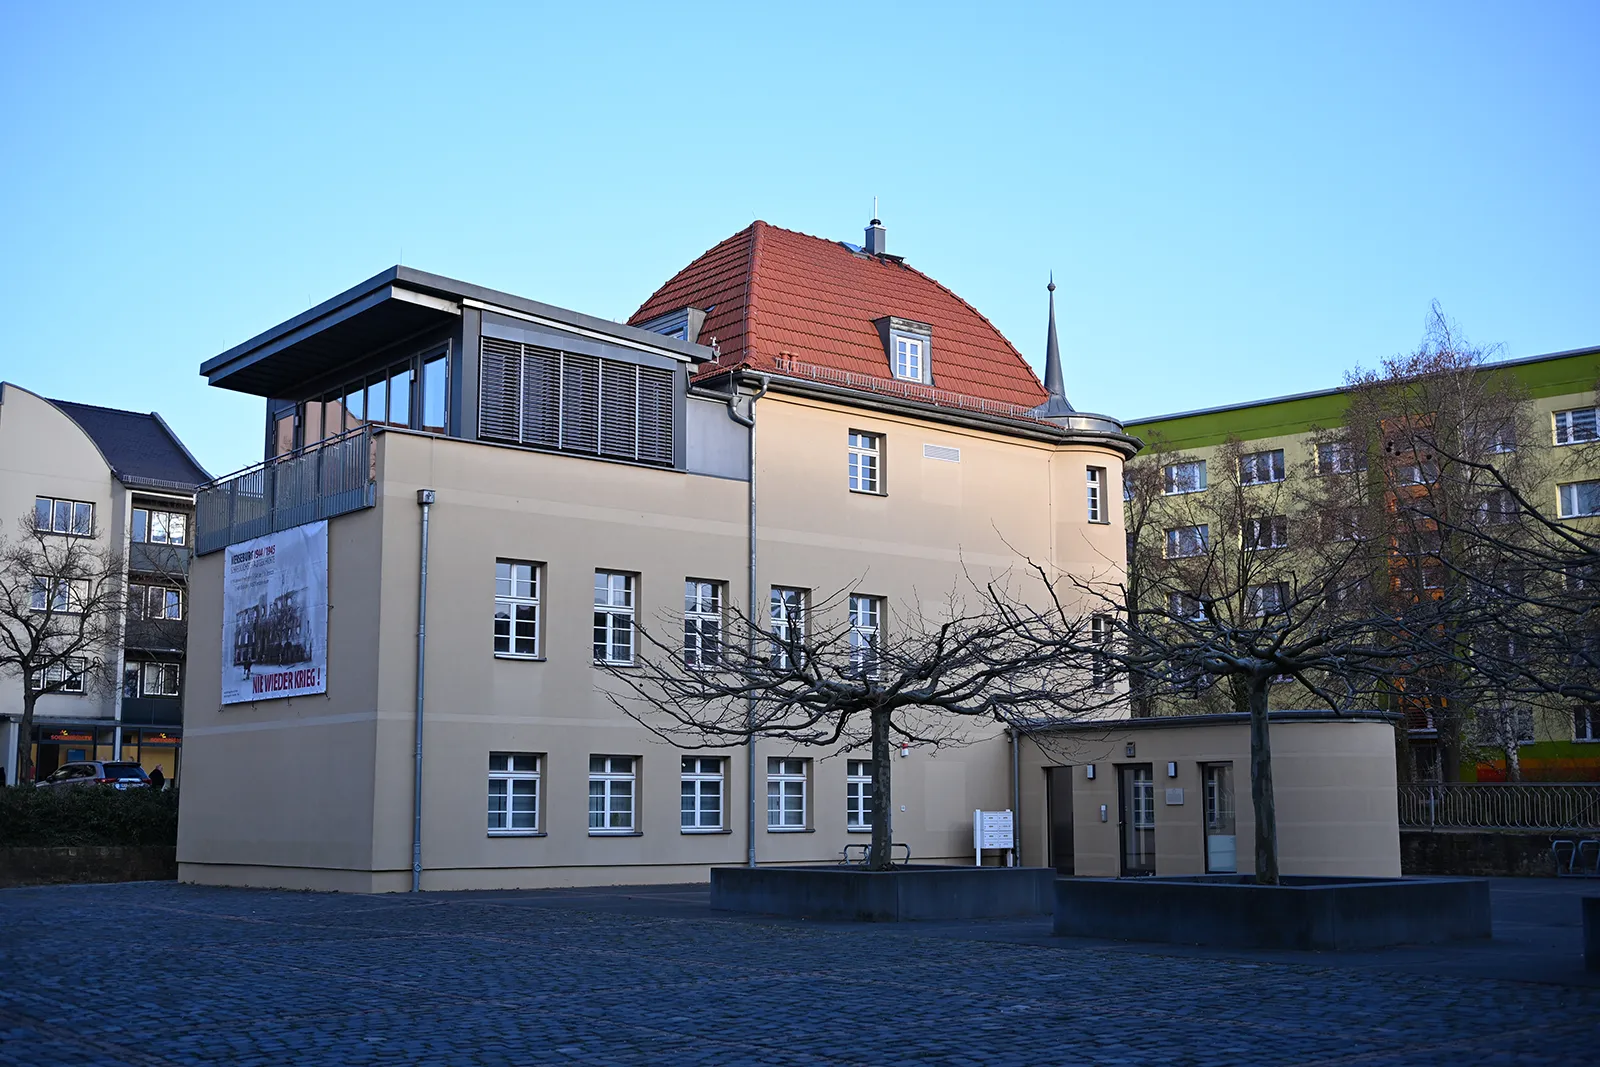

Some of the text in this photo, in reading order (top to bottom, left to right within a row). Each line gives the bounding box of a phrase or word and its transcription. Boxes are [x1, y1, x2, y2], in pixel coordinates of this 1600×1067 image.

[231, 550, 253, 565] MERSEBURG
[252, 675, 263, 694] NIE
[264, 670, 293, 692] WIEDER
[294, 668, 315, 689] KRIEG
